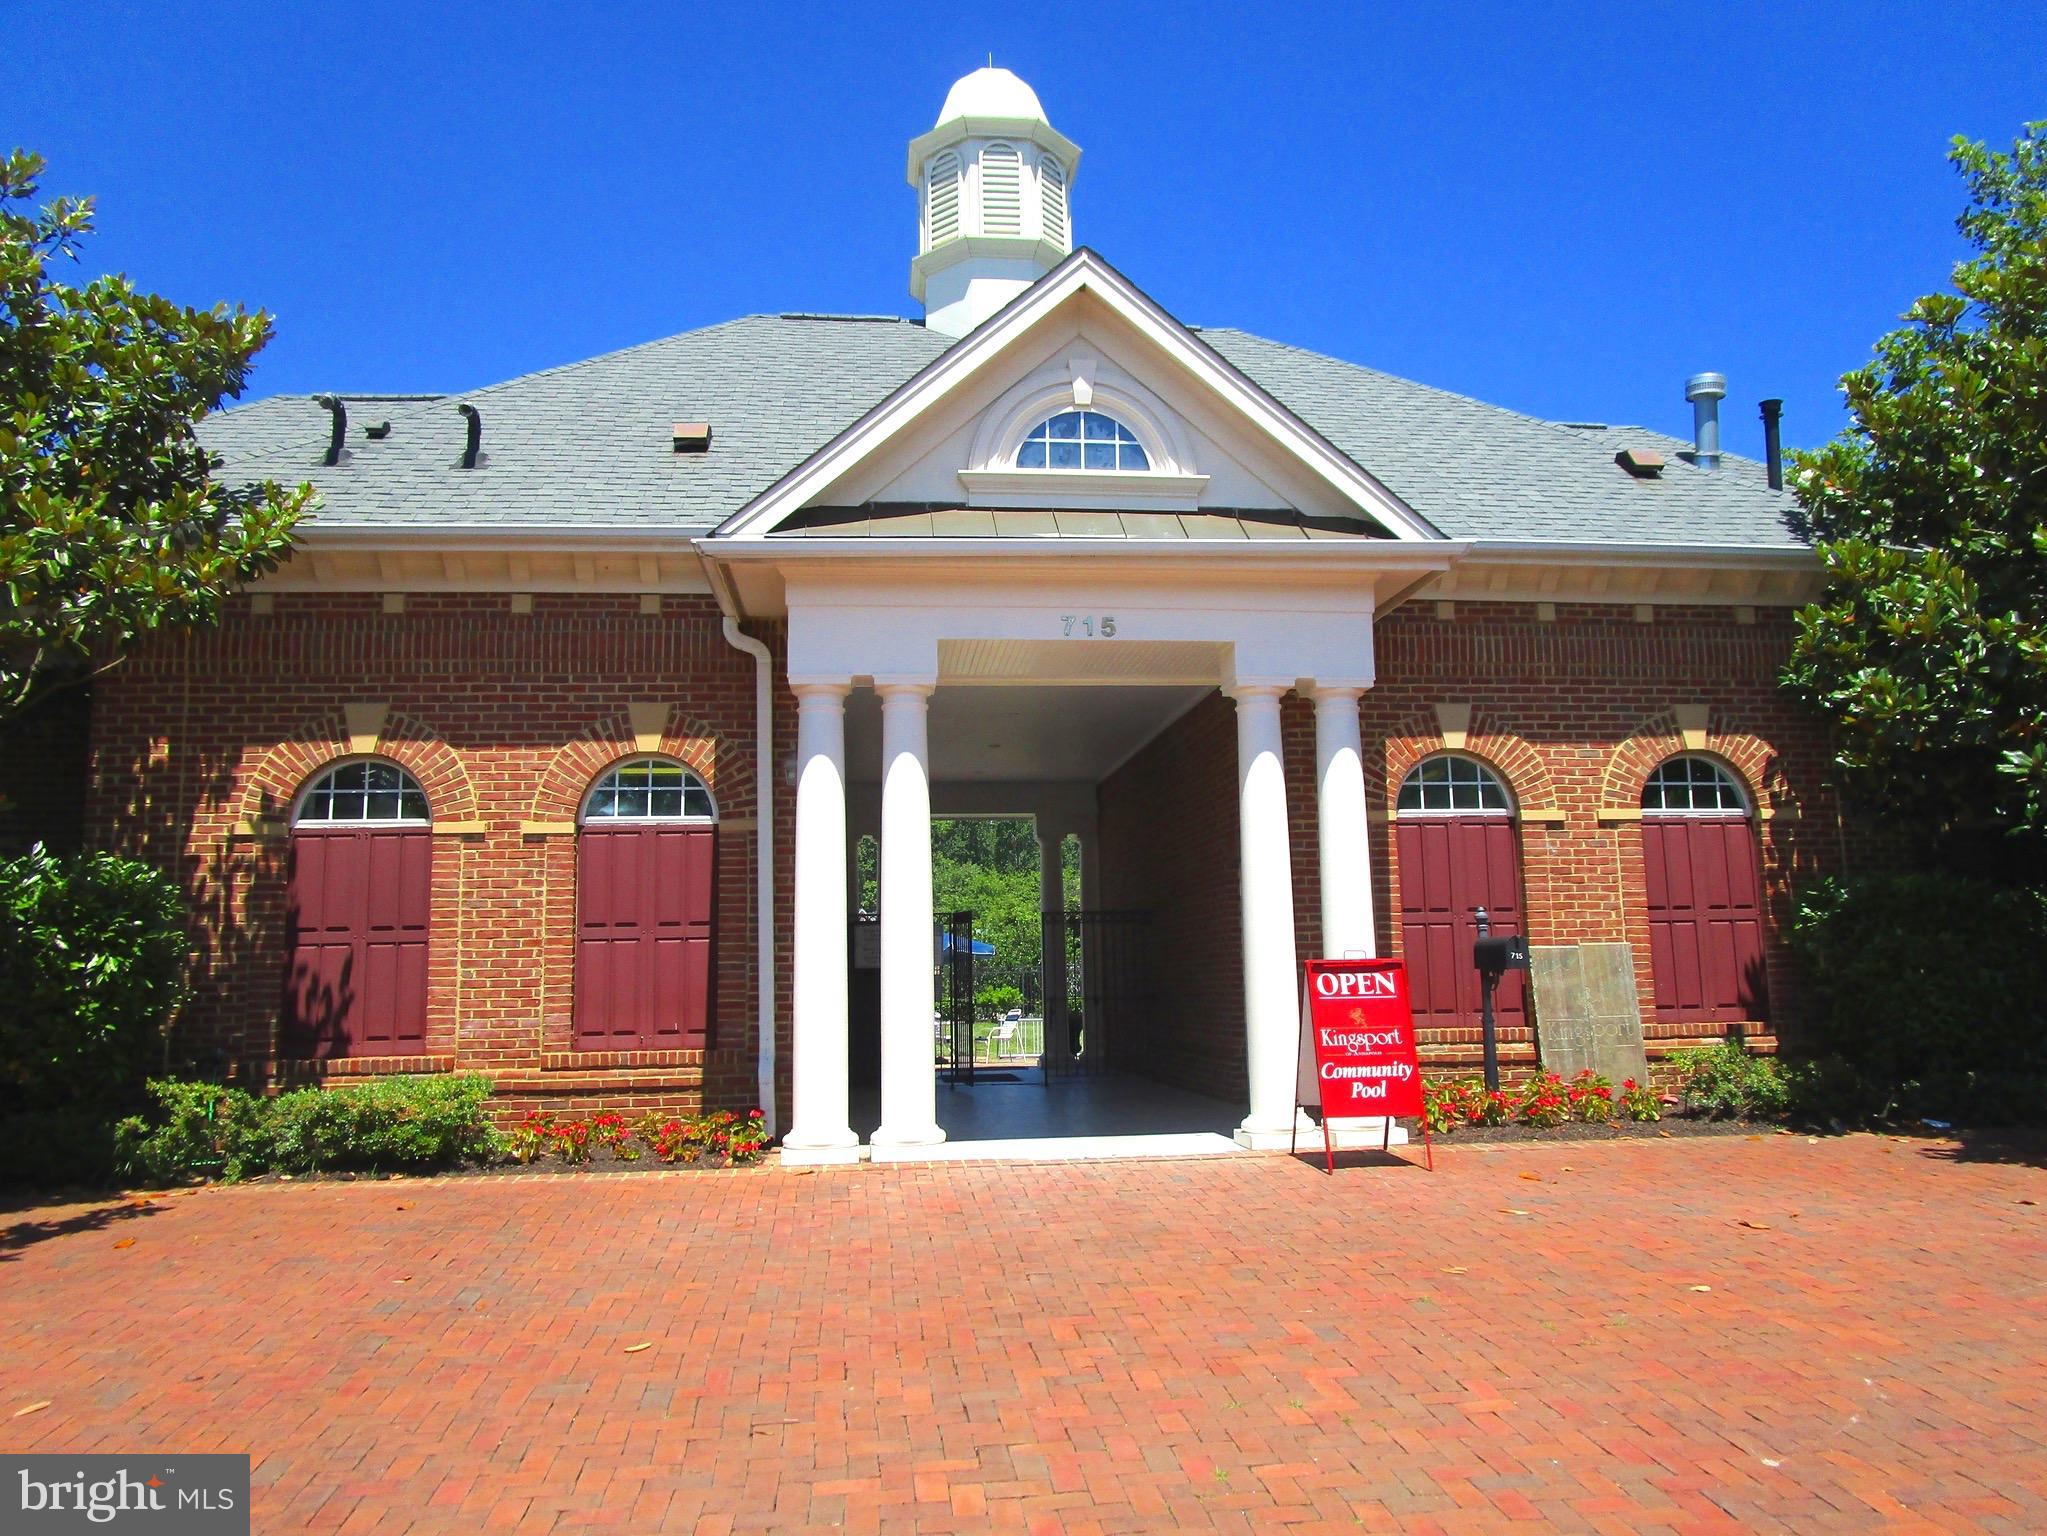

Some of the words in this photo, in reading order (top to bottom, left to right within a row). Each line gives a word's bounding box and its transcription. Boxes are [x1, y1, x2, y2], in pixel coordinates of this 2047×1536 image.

[1060, 615, 1117, 638] 715
[1510, 951, 1524, 960] 715
[1316, 972, 1396, 996] OPEN
[1320, 1028, 1403, 1052] Kingsport
[1548, 1020, 1635, 1047] Kingsport
[1320, 1061, 1413, 1081] Community
[1351, 1081, 1387, 1099] Pool
